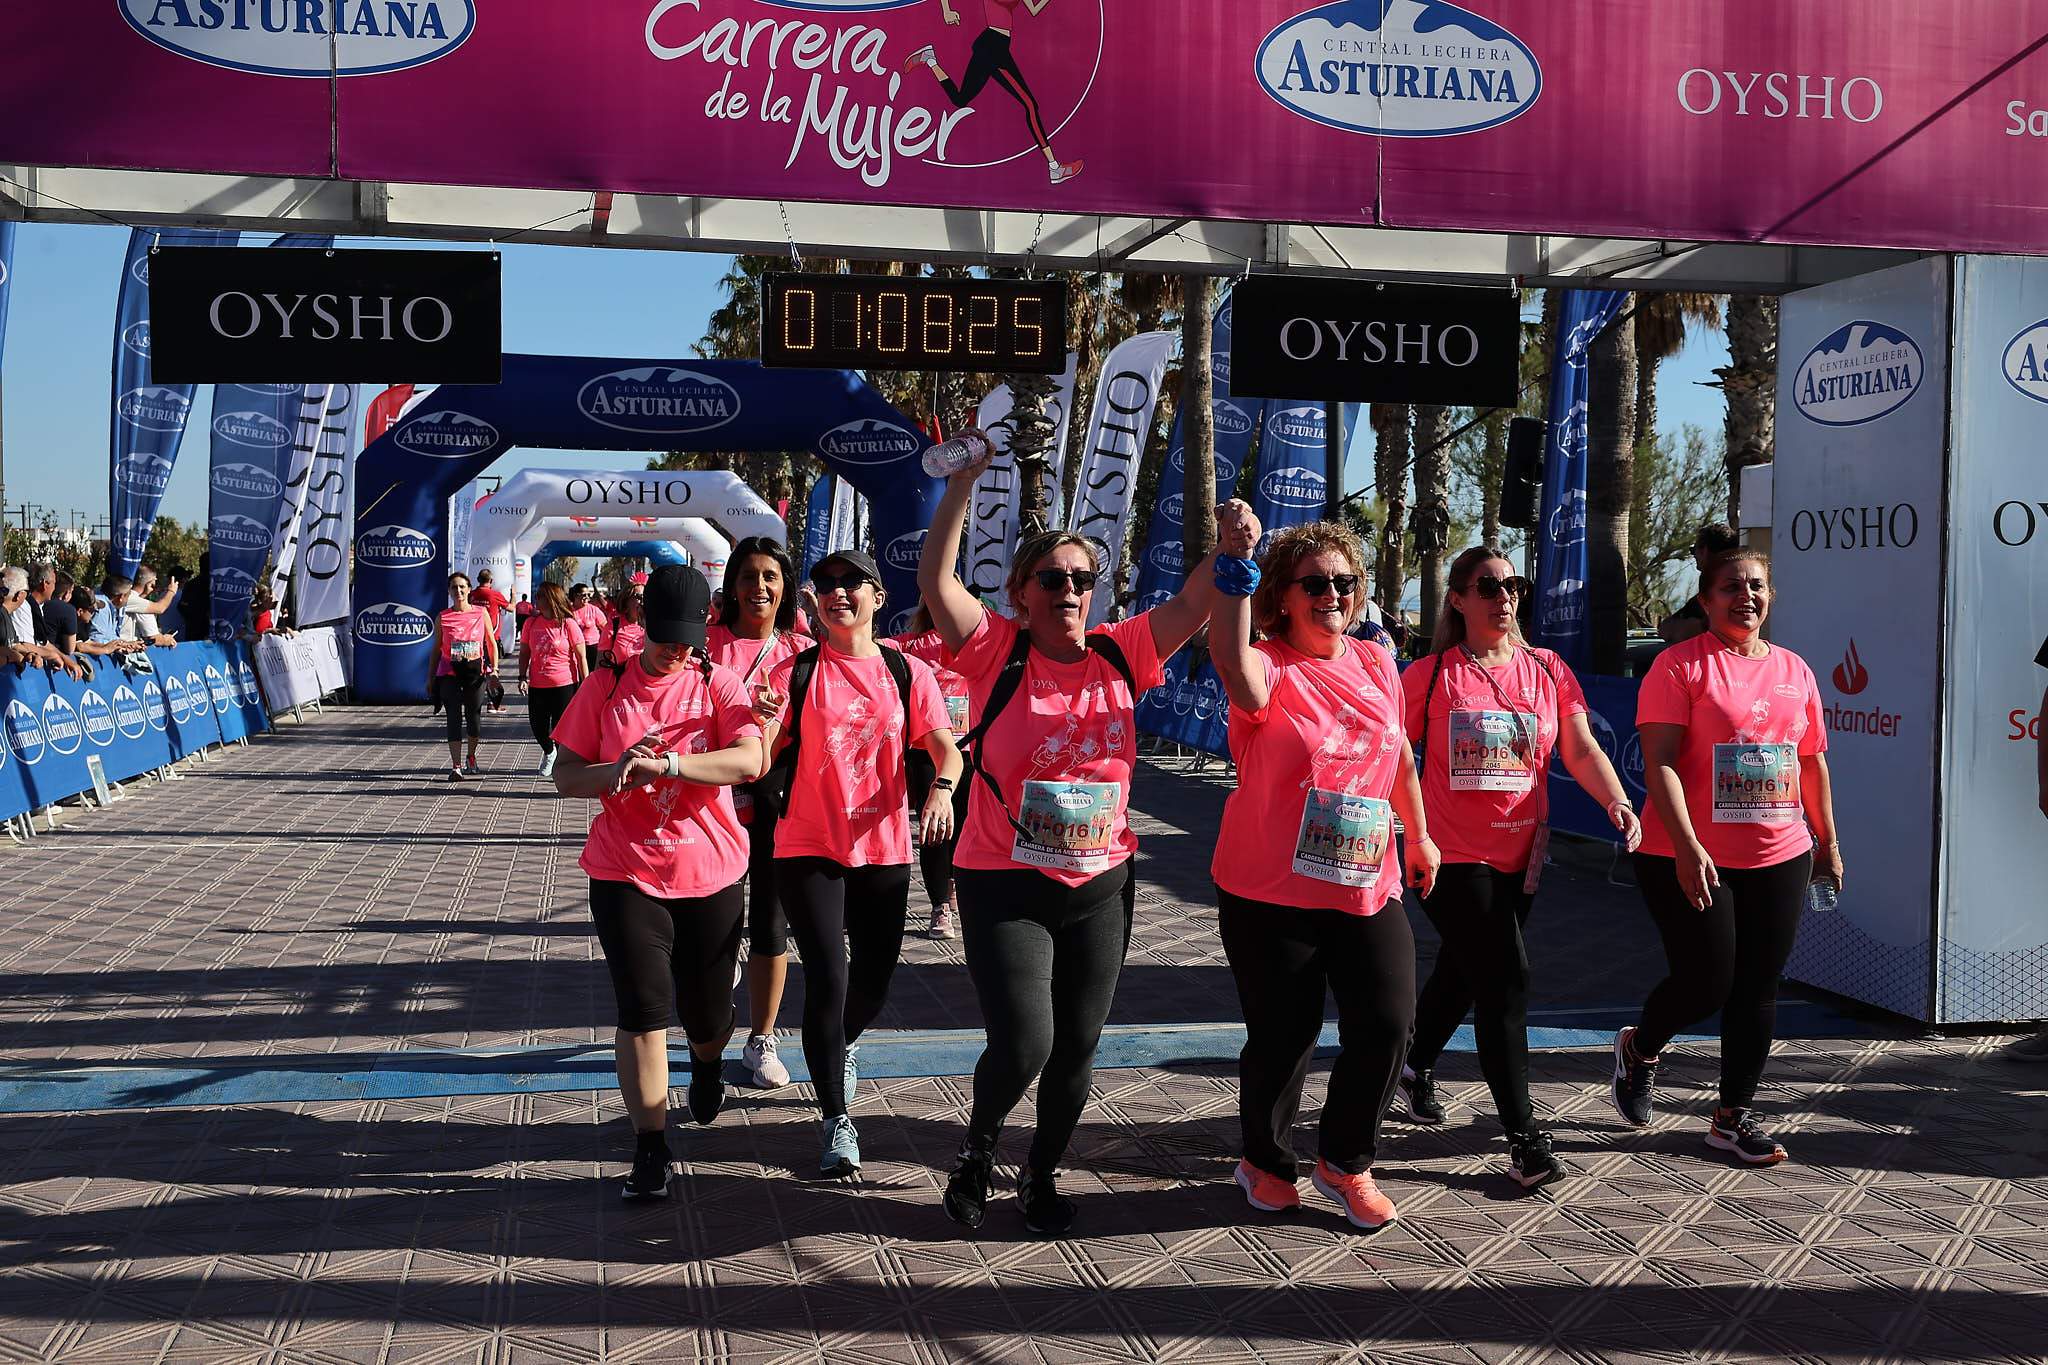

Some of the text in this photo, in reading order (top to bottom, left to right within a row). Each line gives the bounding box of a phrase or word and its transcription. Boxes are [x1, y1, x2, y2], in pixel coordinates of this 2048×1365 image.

[645, 0, 888, 76] Carrera
[1323, 39, 1511, 62] CENTRAL LECHERA
[1278, 39, 1520, 103] ASTURIANA
[1677, 68, 1883, 123] OYSHO
[705, 70, 976, 187] de la Mujer
[209, 291, 452, 342] OYSHO
[1280, 317, 1478, 367] OYSHO
[1820, 349, 1909, 373] CENTRAL LECHERA
[616, 386, 724, 395] CENTRAL LECHERA
[1801, 364, 1913, 405] ASTURIANA
[590, 386, 729, 417] ASTURIANA
[219, 421, 286, 444] ASTURIANA
[400, 426, 491, 447] ASTURIANA
[828, 436, 913, 454] ASTURIANA
[566, 479, 691, 505] OYSHO
[489, 506, 528, 516] OYSHO
[214, 529, 268, 546] STURIANA
[1791, 503, 1918, 552] OYSHO
[360, 541, 431, 559] ASTURIANA
[471, 556, 508, 566] OYSHO
[359, 618, 429, 636] ASTURIANA
[1480, 746, 1508, 759] 016
[1744, 779, 1776, 792] 016
[1723, 811, 1752, 819] OYSHO
[1303, 863, 1335, 877] OYSHO
